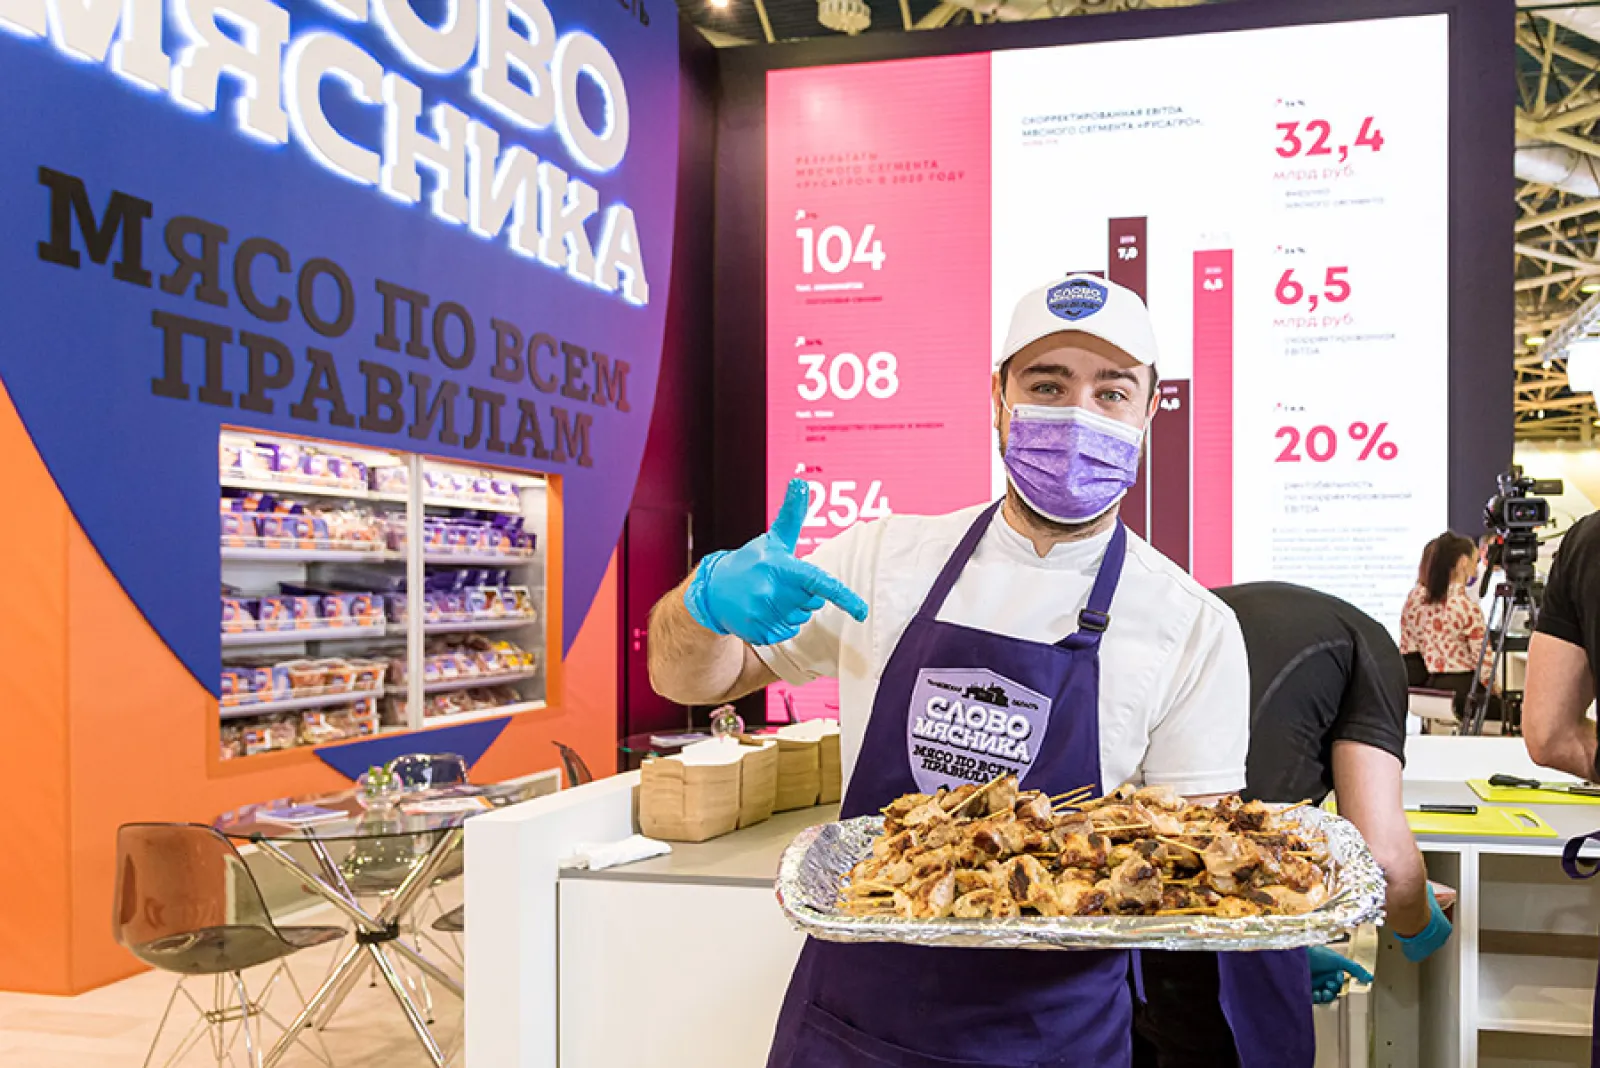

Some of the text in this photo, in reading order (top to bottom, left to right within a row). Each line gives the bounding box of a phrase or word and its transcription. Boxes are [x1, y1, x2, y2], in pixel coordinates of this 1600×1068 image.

[1275, 115, 1385, 163] 32,4
[929, 171, 965, 183] ГОДУ
[796, 224, 886, 274] 104
[38, 165, 632, 413] МЯСО ПО ВСЕМ
[1275, 266, 1351, 313] 6,5
[150, 309, 594, 467] ПРАВИЛАМ
[797, 351, 899, 401] 308
[1274, 420, 1399, 463] 20 %
[800, 480, 892, 527] 254
[912, 715, 1031, 765] МЯСНИКА
[926, 695, 1031, 741] СЛОВО
[912, 744, 1020, 779] МЯСО ПО ВСЕМ
[921, 758, 997, 785] ПРАВИЛА
